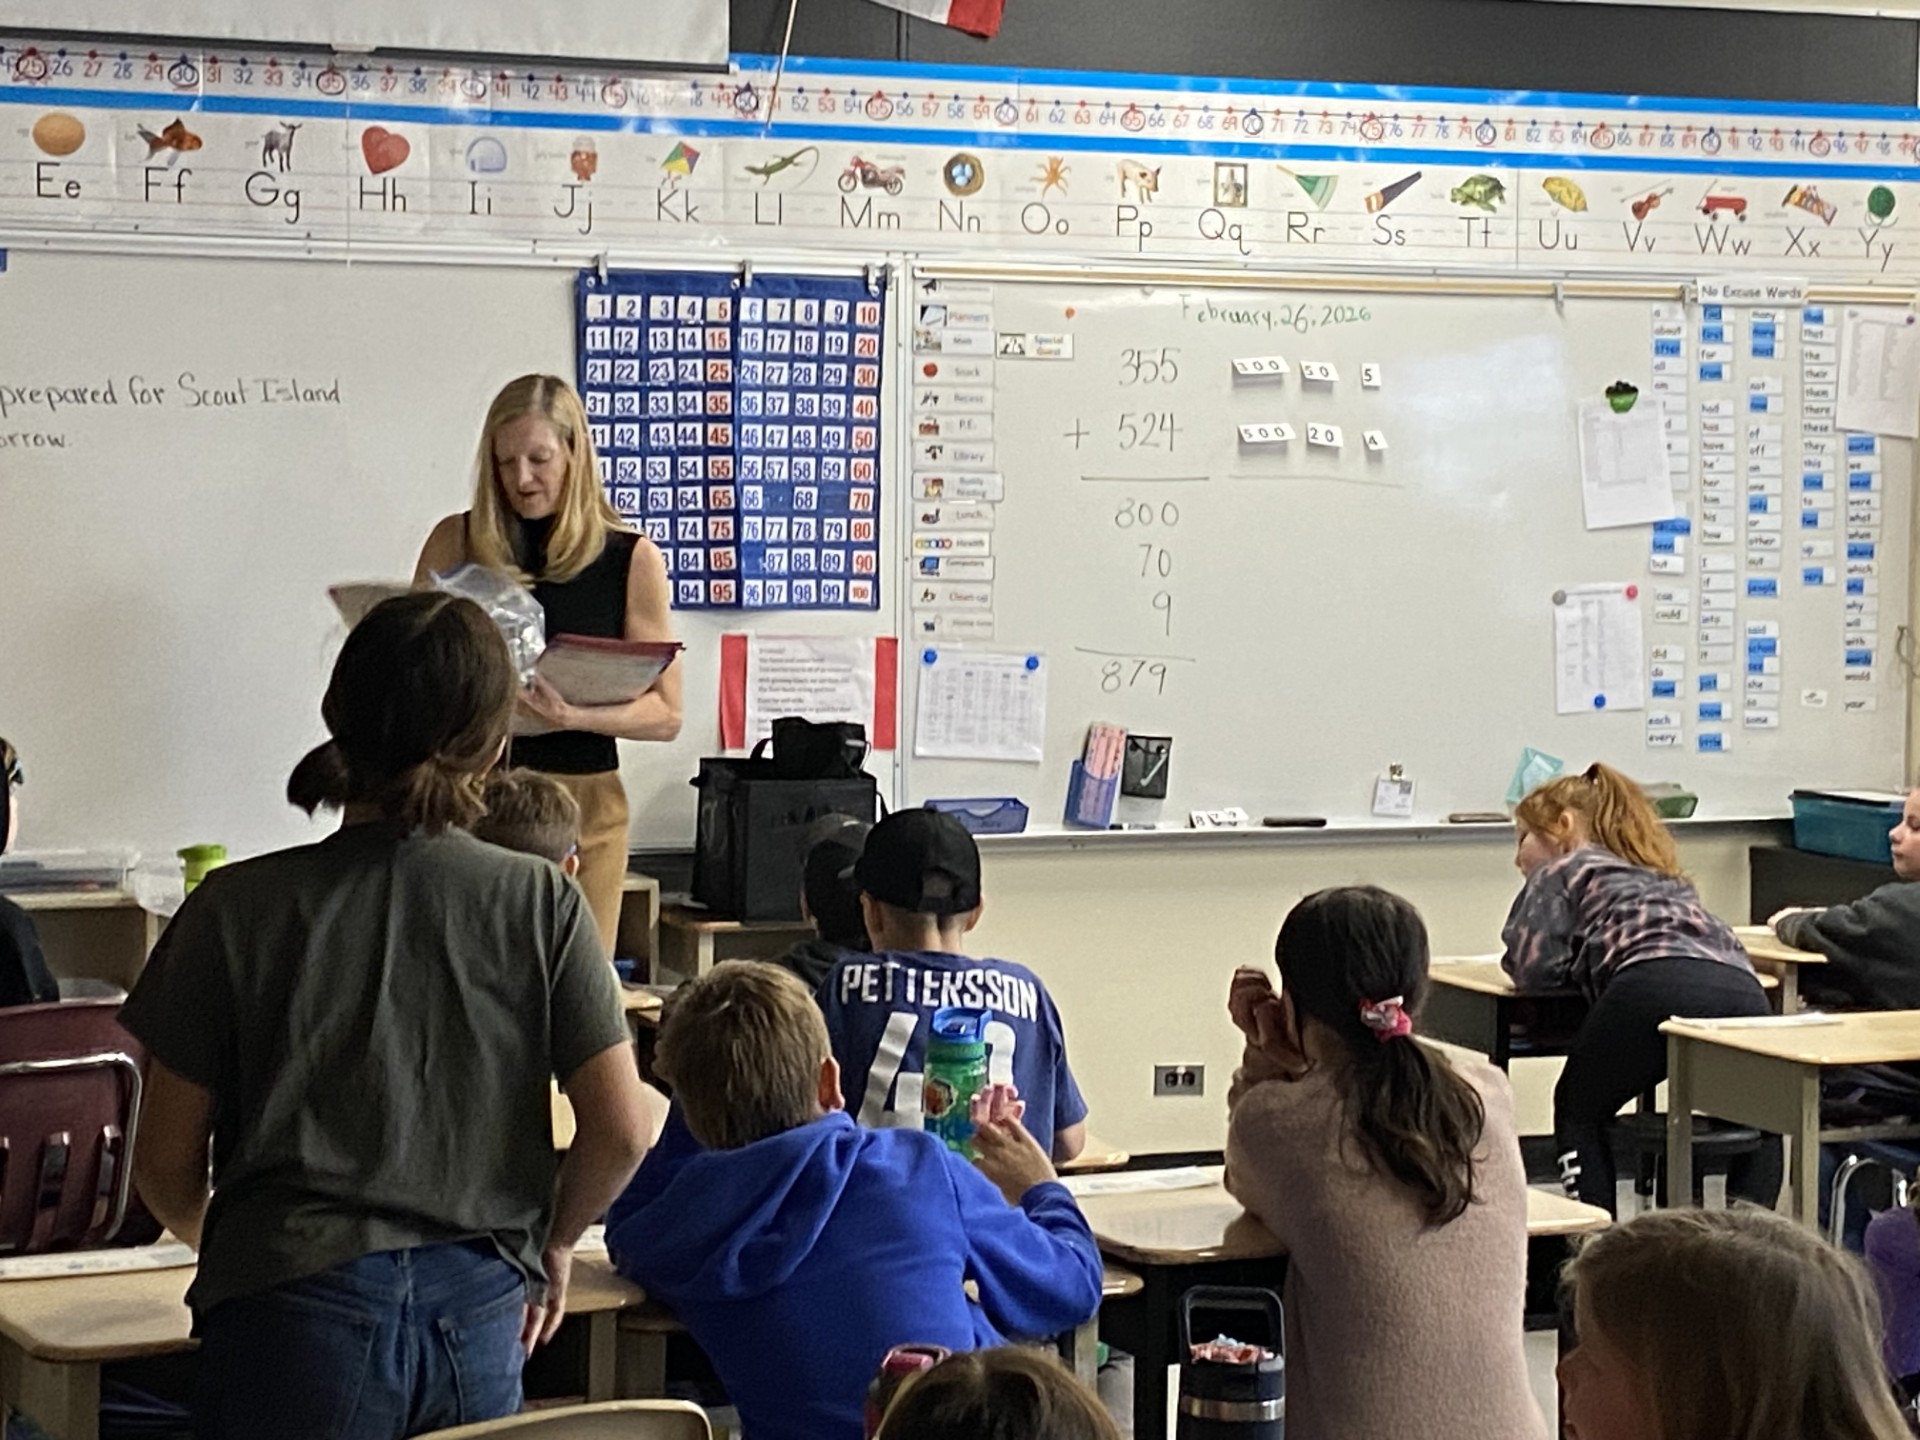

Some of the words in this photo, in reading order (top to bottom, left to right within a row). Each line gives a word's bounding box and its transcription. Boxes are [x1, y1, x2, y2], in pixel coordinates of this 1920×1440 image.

[52, 61, 72, 76] 26
[84, 63, 101, 77] 27
[114, 63, 132, 79] 28
[145, 65, 163, 80] 29
[207, 68, 221, 83] 31
[234, 69, 252, 84] 32
[264, 71, 282, 86] 33
[292, 72, 312, 88] 34
[793, 99, 808, 111] 52
[819, 100, 835, 112] 53
[845, 101, 861, 113] 54
[896, 102, 913, 116] 56
[923, 104, 939, 116] 57
[974, 105, 989, 119] 59
[1026, 109, 1038, 122] 61
[1050, 109, 1065, 123] 62
[1075, 111, 1090, 124] 63
[1099, 112, 1115, 125] 64
[1272, 119, 1283, 132] 71
[1293, 120, 1307, 133] 72
[37, 162, 81, 198] Ee
[145, 167, 192, 203] Ff
[246, 171, 300, 224] Gg
[360, 176, 406, 212] Hh
[470, 181, 491, 215] Ii
[554, 185, 592, 234] Jj
[657, 189, 699, 222] Kk
[841, 196, 900, 228] Mm
[940, 200, 981, 233] Nn
[1022, 202, 1069, 234] Oo
[1117, 205, 1152, 252] Pp
[1199, 208, 1251, 255] Qq
[1287, 212, 1325, 243] Rr
[1373, 214, 1405, 245] Ss
[1459, 217, 1491, 248] Tt
[1539, 219, 1577, 249] Uu
[1623, 222, 1655, 252] Vv
[1695, 224, 1751, 255] Ww
[1785, 226, 1820, 257] Xx
[1858, 228, 1894, 272] Yy
[1702, 286, 1718, 296] No
[1723, 286, 1760, 297] Excuse
[1766, 287, 1801, 298] Words
[600, 300, 605, 316] 1
[627, 300, 635, 317] 2
[661, 301, 669, 317] 3
[688, 301, 696, 316] 4
[719, 302, 727, 318] 5
[749, 302, 757, 319] 6
[778, 303, 785, 319] 7
[805, 304, 812, 320] 8
[835, 305, 843, 321] 9
[861, 307, 876, 323] 10
[591, 331, 605, 348] 11
[617, 331, 633, 348] 12
[652, 332, 668, 348] 13
[681, 332, 696, 348] 14
[710, 332, 726, 348] 15
[743, 332, 758, 349] 16
[769, 334, 785, 350] 17
[798, 335, 813, 352] 18
[828, 336, 843, 352] 19
[859, 338, 875, 355] 20
[1702, 350, 1716, 358] for
[1805, 351, 1820, 360] the
[1119, 348, 1181, 385] 355
[589, 364, 605, 380] 21
[616, 364, 634, 380] 22
[651, 362, 669, 379] 23
[680, 363, 698, 379] 24
[710, 363, 729, 380] 25
[742, 365, 758, 380] 26
[767, 366, 784, 383] 27
[794, 367, 811, 384] 28
[824, 368, 842, 384] 29
[858, 368, 875, 385] 30
[1305, 366, 1328, 377] 50
[1364, 369, 1372, 381] 5
[1805, 370, 1827, 378] their
[0, 379, 117, 418] prepared
[129, 375, 164, 405] for
[178, 372, 248, 407] Scout
[255, 378, 340, 403] Island
[1805, 388, 1828, 397] them
[588, 396, 605, 412] 31
[616, 396, 634, 413] 32
[651, 396, 668, 413] 33
[679, 396, 697, 412] 34
[709, 396, 728, 412] 35
[742, 396, 757, 412] 36
[768, 397, 784, 413] 37
[796, 398, 814, 415] 38
[824, 399, 841, 415] 39
[856, 400, 873, 416] 40
[1805, 406, 1830, 414] there
[1119, 412, 1183, 452] 524
[1749, 428, 1760, 437] of
[1804, 424, 1828, 432] these
[617, 428, 634, 444] 42
[652, 427, 670, 444] 43
[678, 427, 697, 444] 44
[711, 428, 728, 444] 45
[743, 429, 758, 445] 46
[768, 430, 784, 446] 47
[794, 430, 811, 446] 48
[823, 431, 840, 448] 49
[855, 431, 872, 448] 50
[1244, 427, 1284, 438] 500
[1310, 428, 1334, 442] 20
[1369, 436, 1378, 445] 4
[1750, 445, 1765, 455] off
[1804, 441, 1825, 453] they
[619, 462, 636, 479] 52
[648, 461, 665, 478] 53
[680, 462, 698, 478] 54
[711, 461, 729, 478] 55
[743, 461, 758, 477] 56
[768, 462, 784, 478] 57
[794, 462, 811, 478] 58
[824, 462, 840, 479] 59
[854, 462, 871, 479] 60
[1804, 460, 1821, 468] this
[1115, 498, 1179, 528] 800
[1849, 514, 1870, 522] what
[1749, 536, 1775, 546] other
[1140, 544, 1171, 578] 70
[1847, 565, 1872, 573] which
[1153, 591, 1171, 636] 9
[1846, 602, 1863, 612] why
[1846, 637, 1865, 645] with
[1102, 660, 1166, 695] 879
[1845, 700, 1865, 710] your
[1649, 733, 1676, 744] every
[842, 962, 1038, 1023] PETTERSSON
